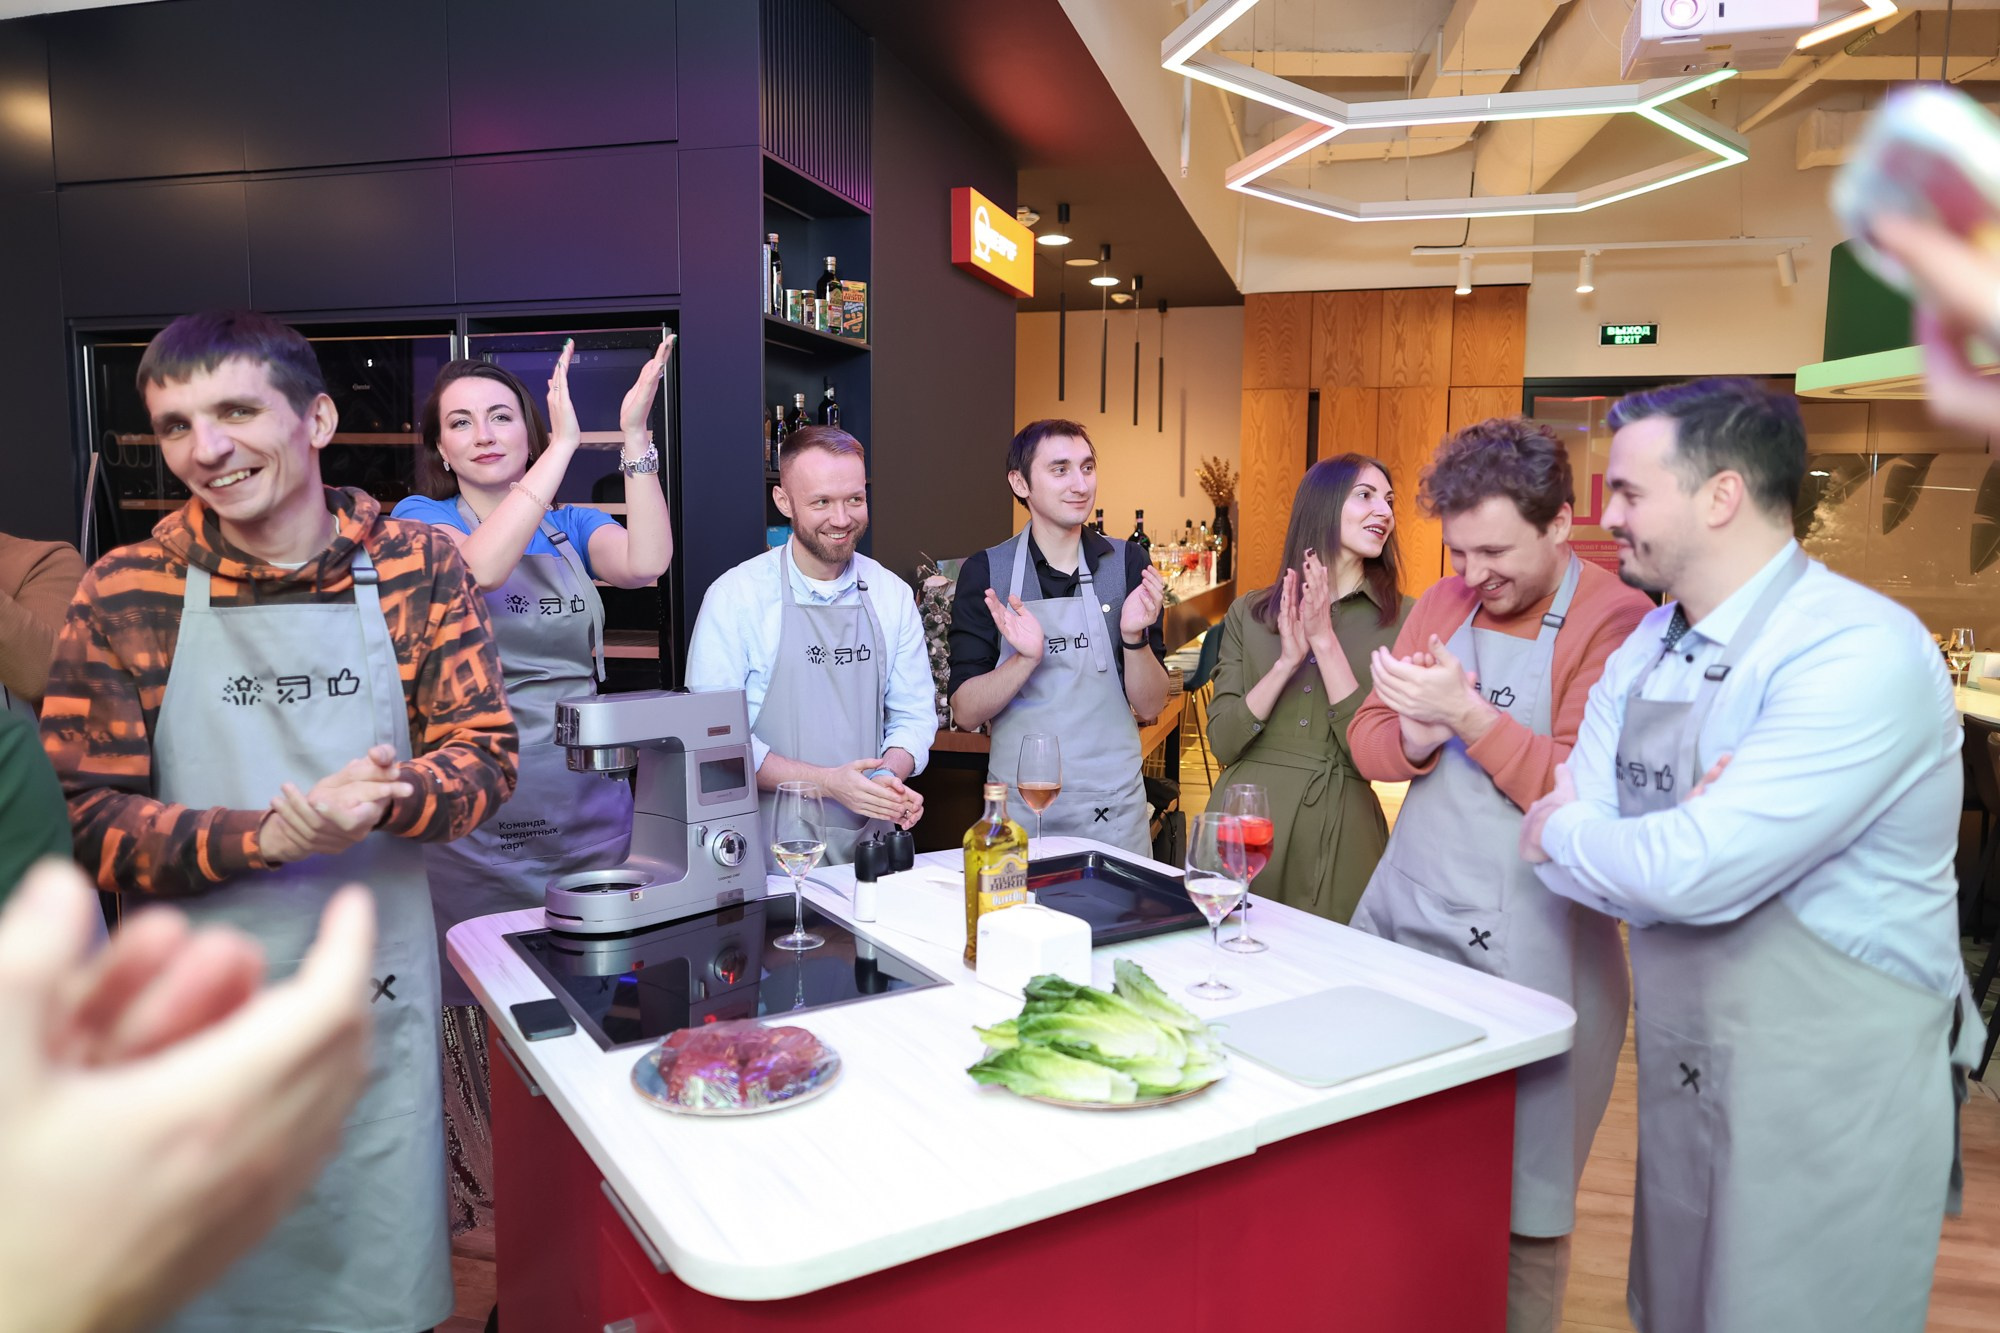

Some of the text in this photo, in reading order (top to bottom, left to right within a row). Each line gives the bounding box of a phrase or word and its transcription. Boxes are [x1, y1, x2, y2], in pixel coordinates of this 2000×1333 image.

[1606, 326, 1650, 336] ВЫХОД
[1614, 335, 1642, 344] EXIT
[498, 819, 546, 830] Команда
[499, 827, 559, 842] кредитных
[501, 841, 525, 852] карт
